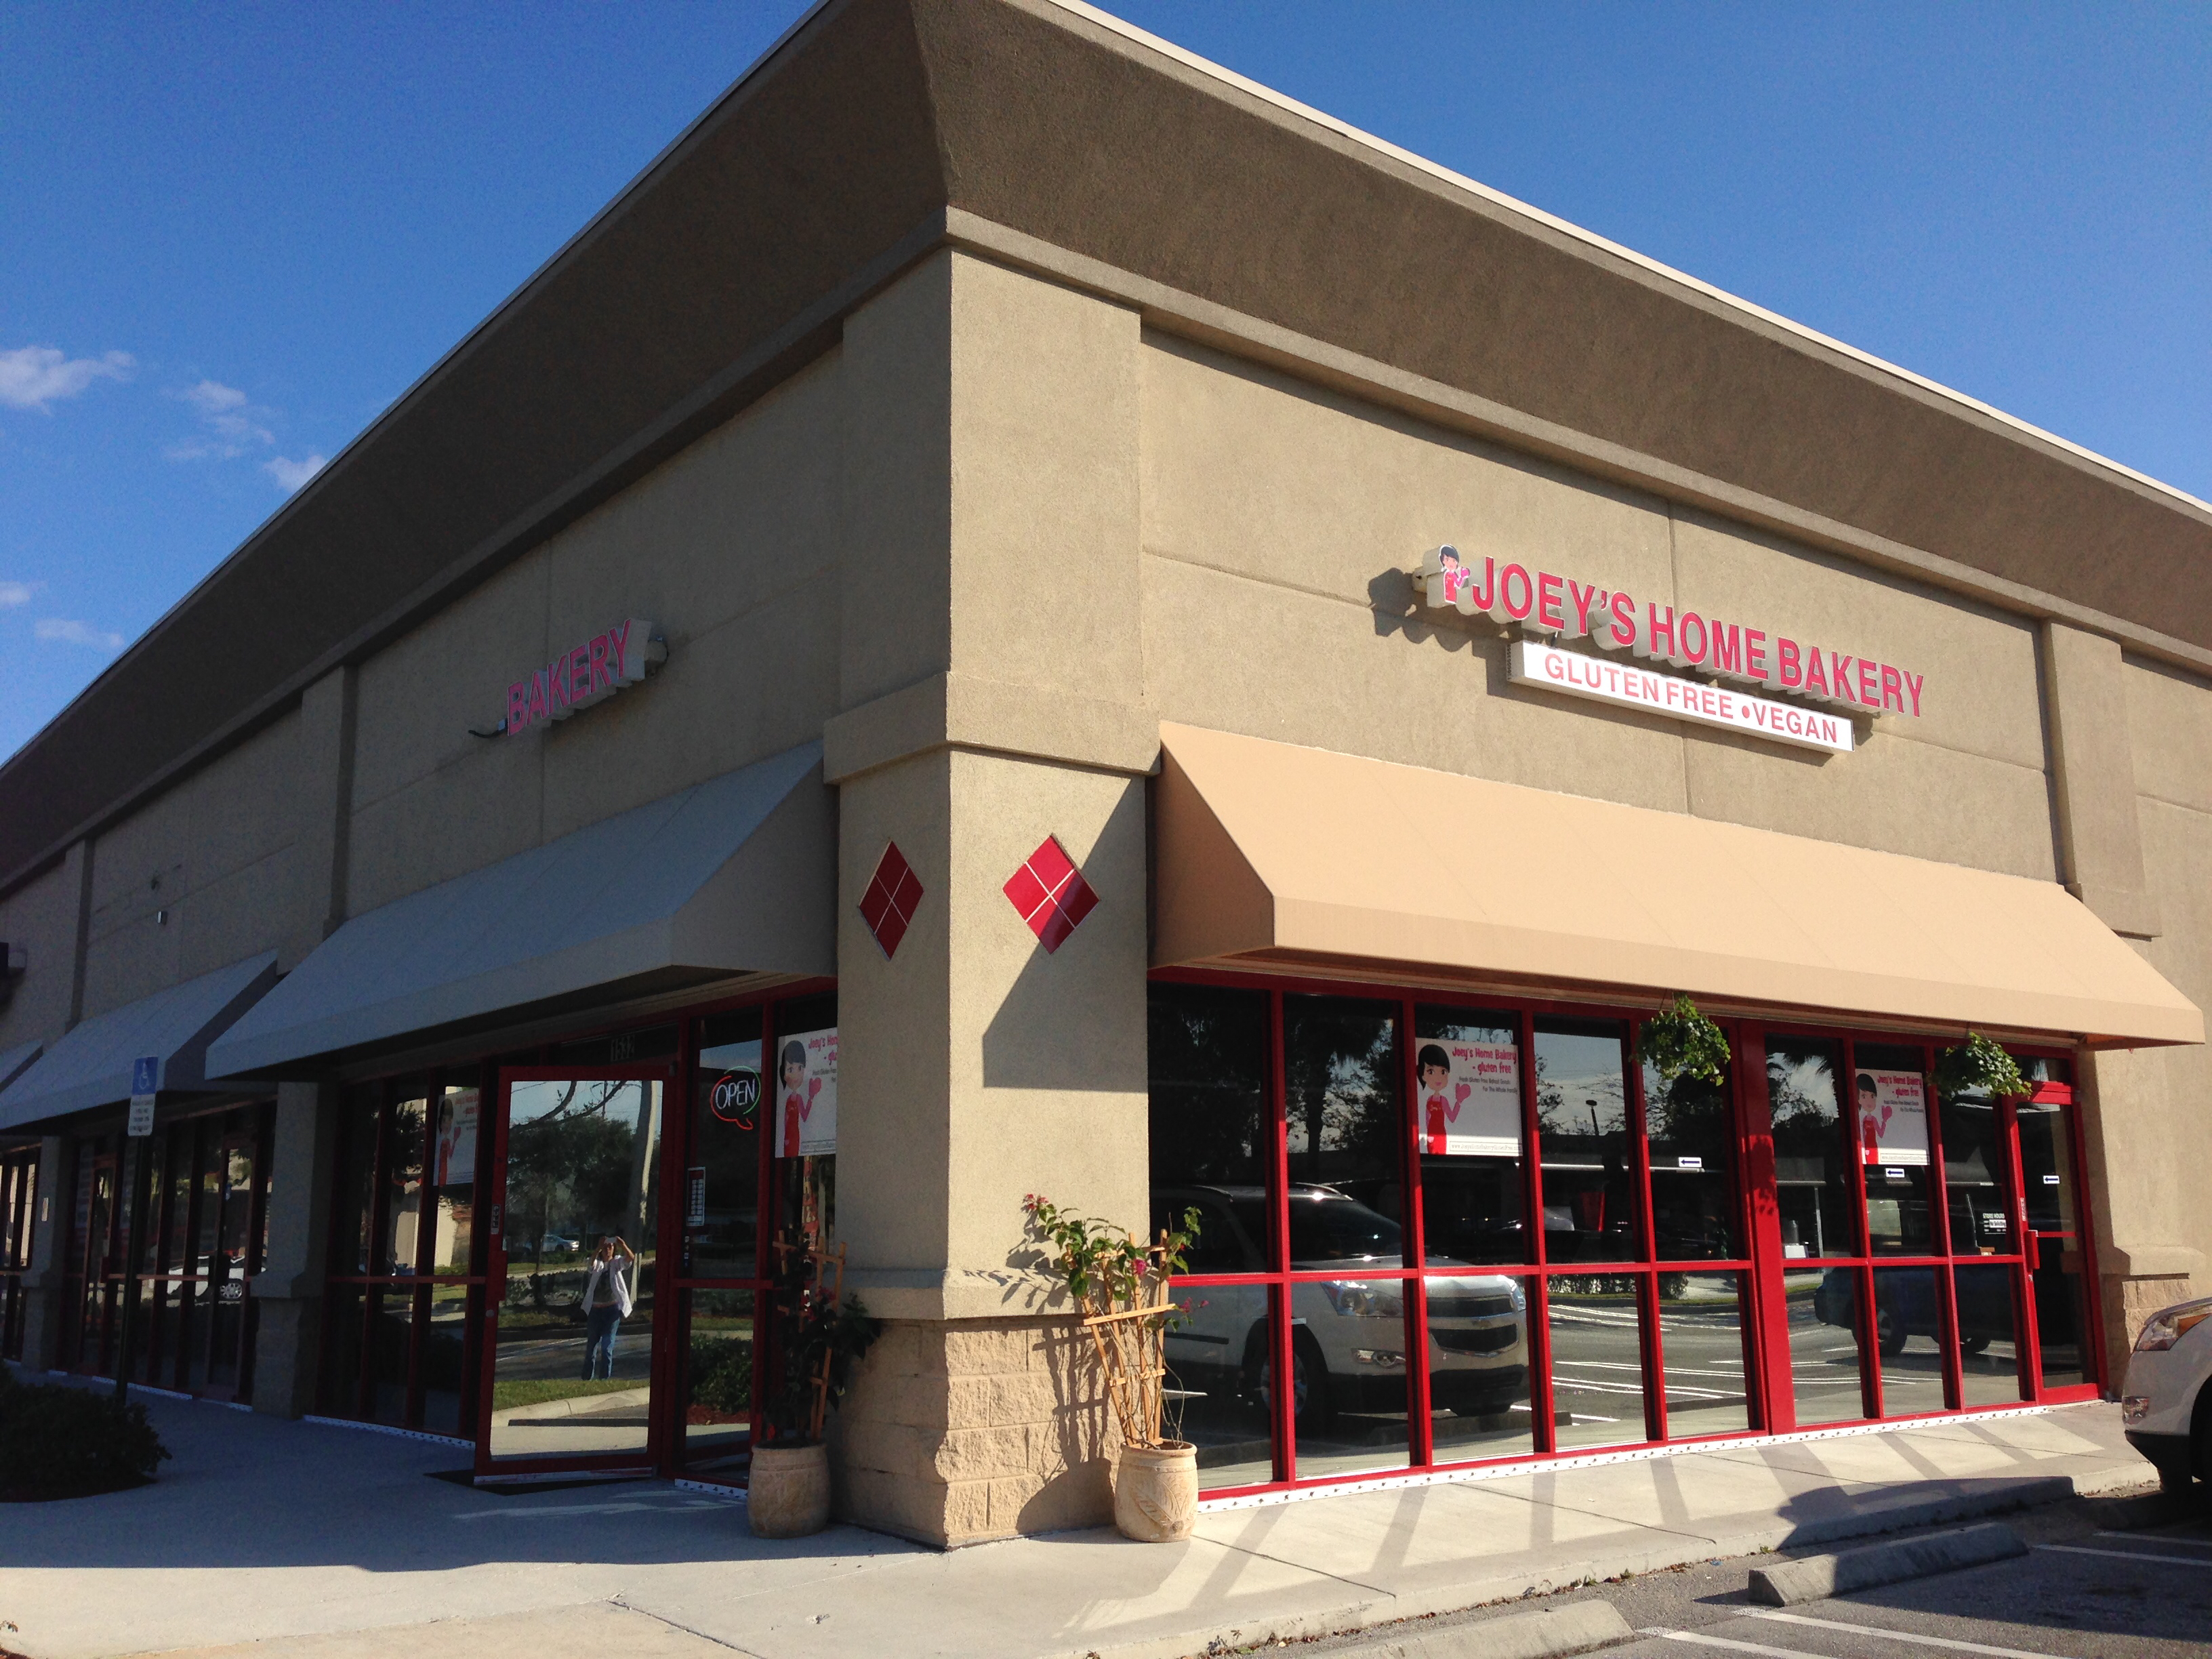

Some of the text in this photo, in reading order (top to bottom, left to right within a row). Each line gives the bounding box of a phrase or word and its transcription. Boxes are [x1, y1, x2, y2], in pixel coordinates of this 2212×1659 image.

[1471, 556, 1925, 718] JOEY'S HOME BAKERY
[508, 617, 632, 736] BAKERY
[1544, 653, 1660, 703] GLUTEN
[1666, 680, 1735, 720] FREE
[1752, 701, 1839, 745] VEGAN
[1452, 1046, 1517, 1065] Joey's Home Bakery
[1477, 1061, 1498, 1076] gluten
[1499, 1061, 1511, 1074] free
[715, 1078, 756, 1109] OPEN
